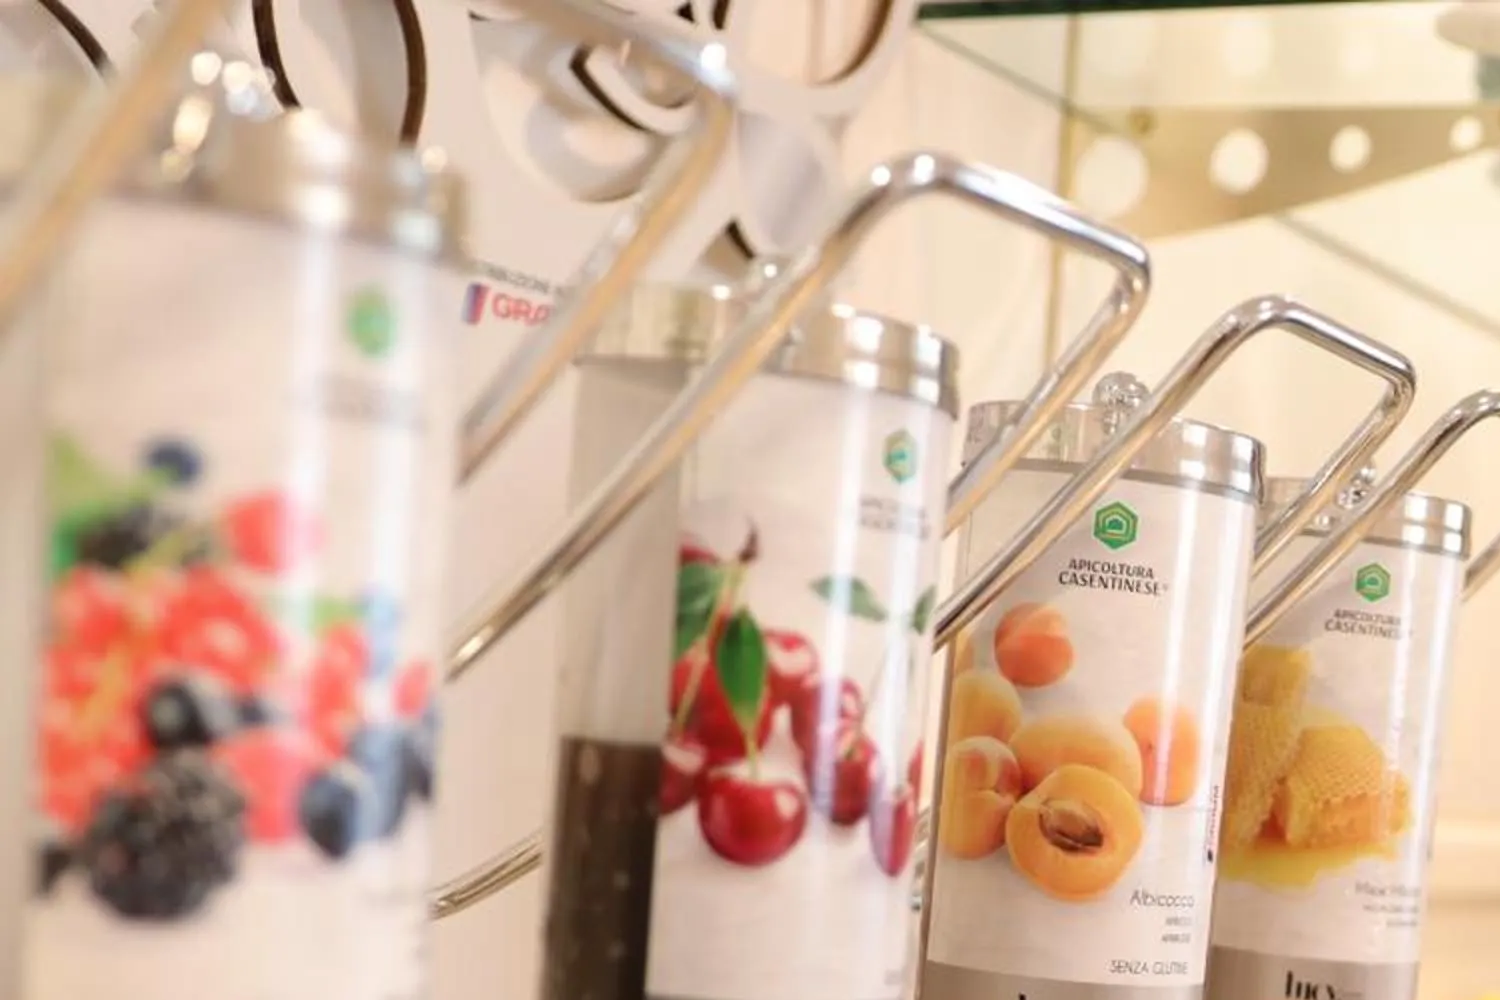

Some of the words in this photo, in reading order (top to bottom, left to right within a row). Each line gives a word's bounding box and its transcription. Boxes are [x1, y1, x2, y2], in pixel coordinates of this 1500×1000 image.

[1068, 558, 1155, 579] APICOLTURA
[1058, 571, 1161, 596] CASENTINESE
[1108, 959, 1149, 975] SENZA
